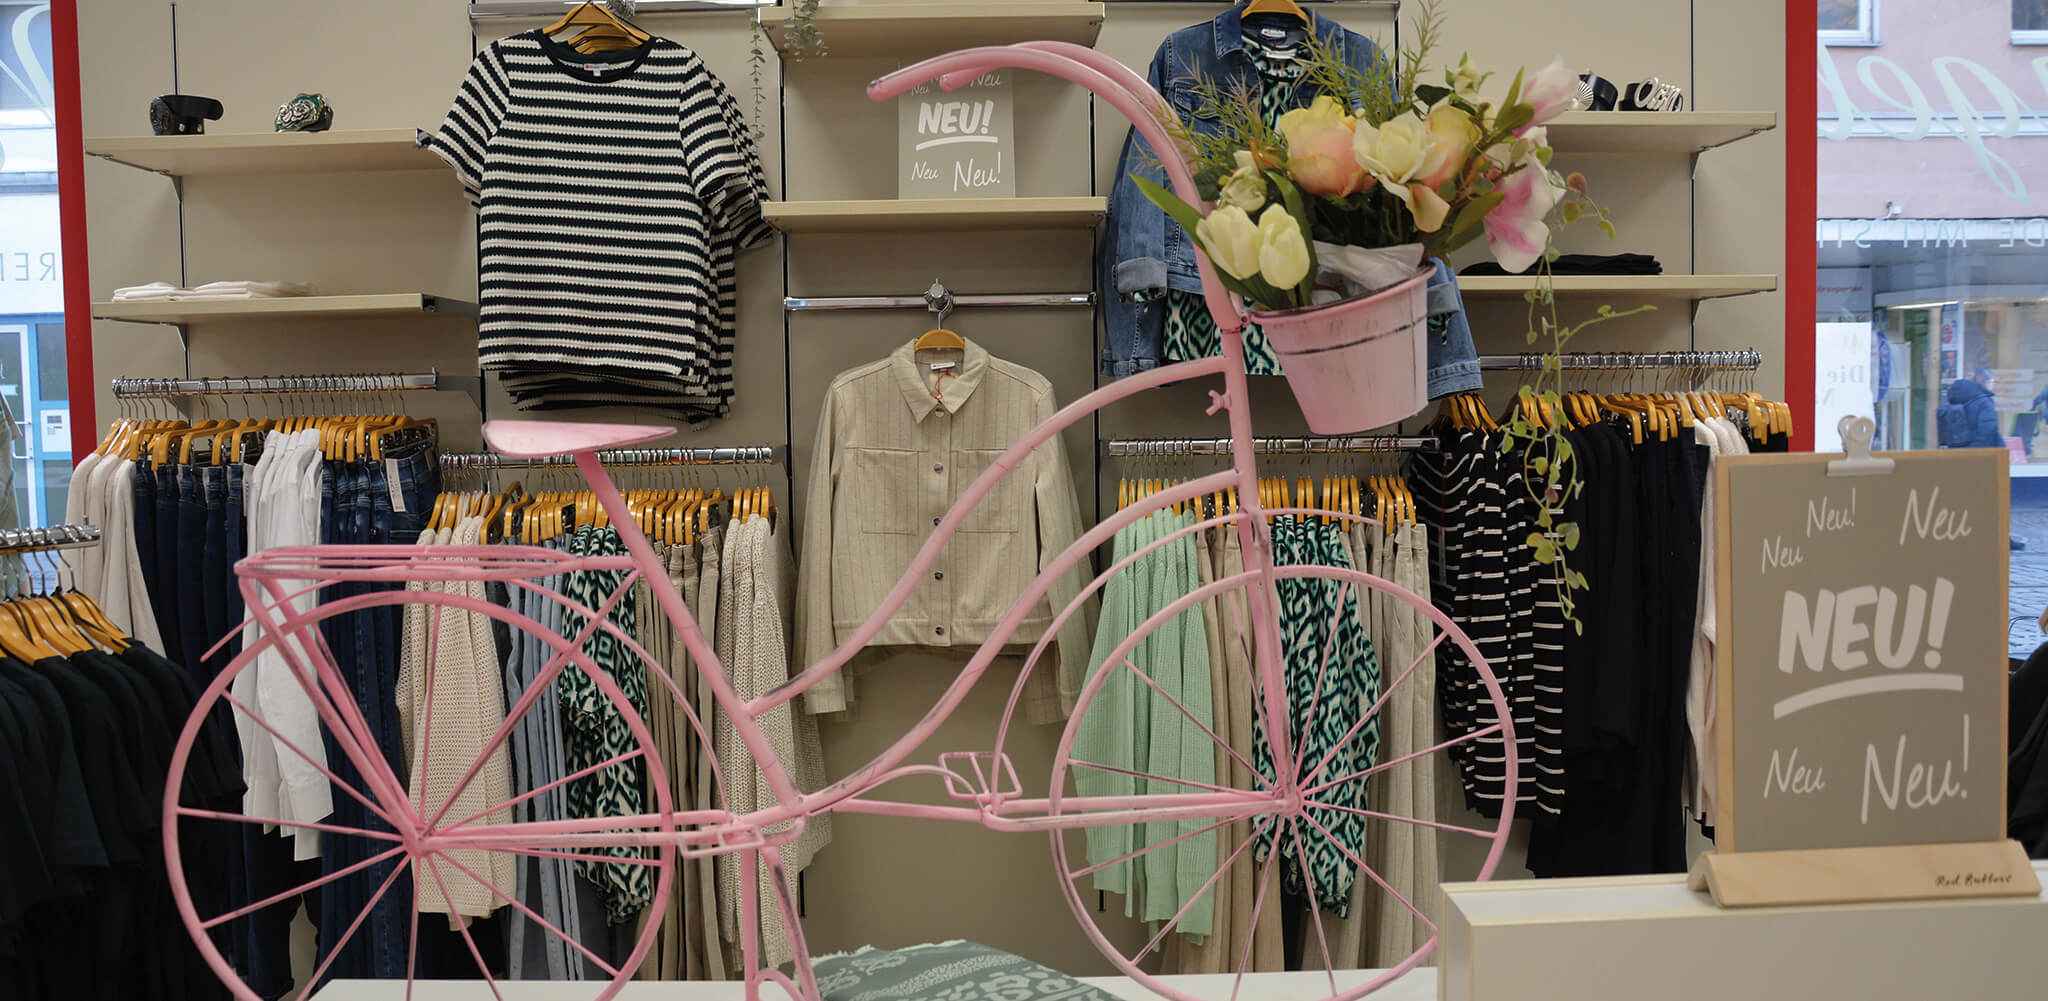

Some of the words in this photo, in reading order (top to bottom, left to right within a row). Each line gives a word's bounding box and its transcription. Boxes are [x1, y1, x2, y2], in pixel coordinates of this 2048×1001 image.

[918, 100, 994, 134] NEU!
[911, 160, 939, 181] Neu
[954, 152, 1001, 192] Neu!
[1807, 488, 1856, 538] Neu!
[1900, 486, 1972, 546] Neu
[1761, 536, 1803, 574] Neu
[1778, 577, 1955, 675] NEU!
[1764, 748, 1826, 799] Neu
[1861, 714, 1970, 825] Neu!
